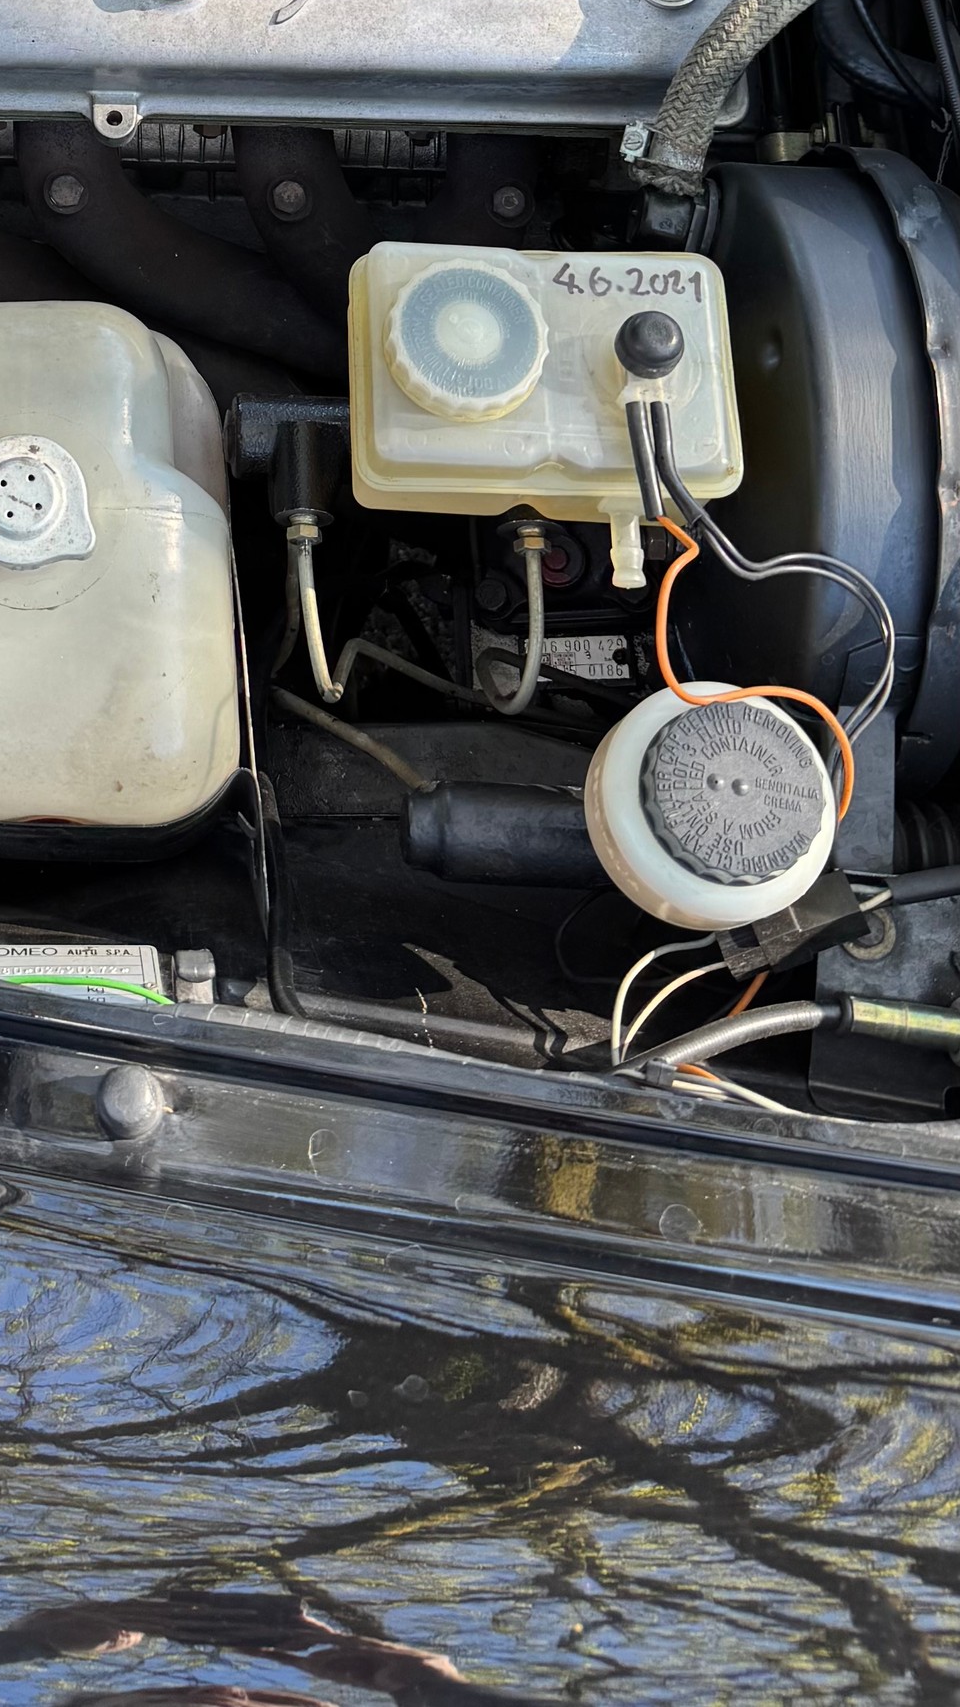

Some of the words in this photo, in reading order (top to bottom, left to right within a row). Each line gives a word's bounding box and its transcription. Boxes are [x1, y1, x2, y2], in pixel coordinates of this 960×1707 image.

[552, 262, 702, 303] 4.6.2021
[564, 639, 591, 652] 900
[588, 663, 623, 677] 0186
[659, 732, 681, 765] CAP
[677, 704, 734, 735] BEFORE
[742, 705, 813, 769] REMOVING
[696, 719, 742, 744] FLUID
[701, 734, 783, 777] CONTAINER
[689, 760, 718, 824] SEALED
[764, 794, 802, 813] CREMA
[739, 809, 782, 840] FROM
[67, 948, 98, 957] AUTO
[87, 985, 105, 994] kg
